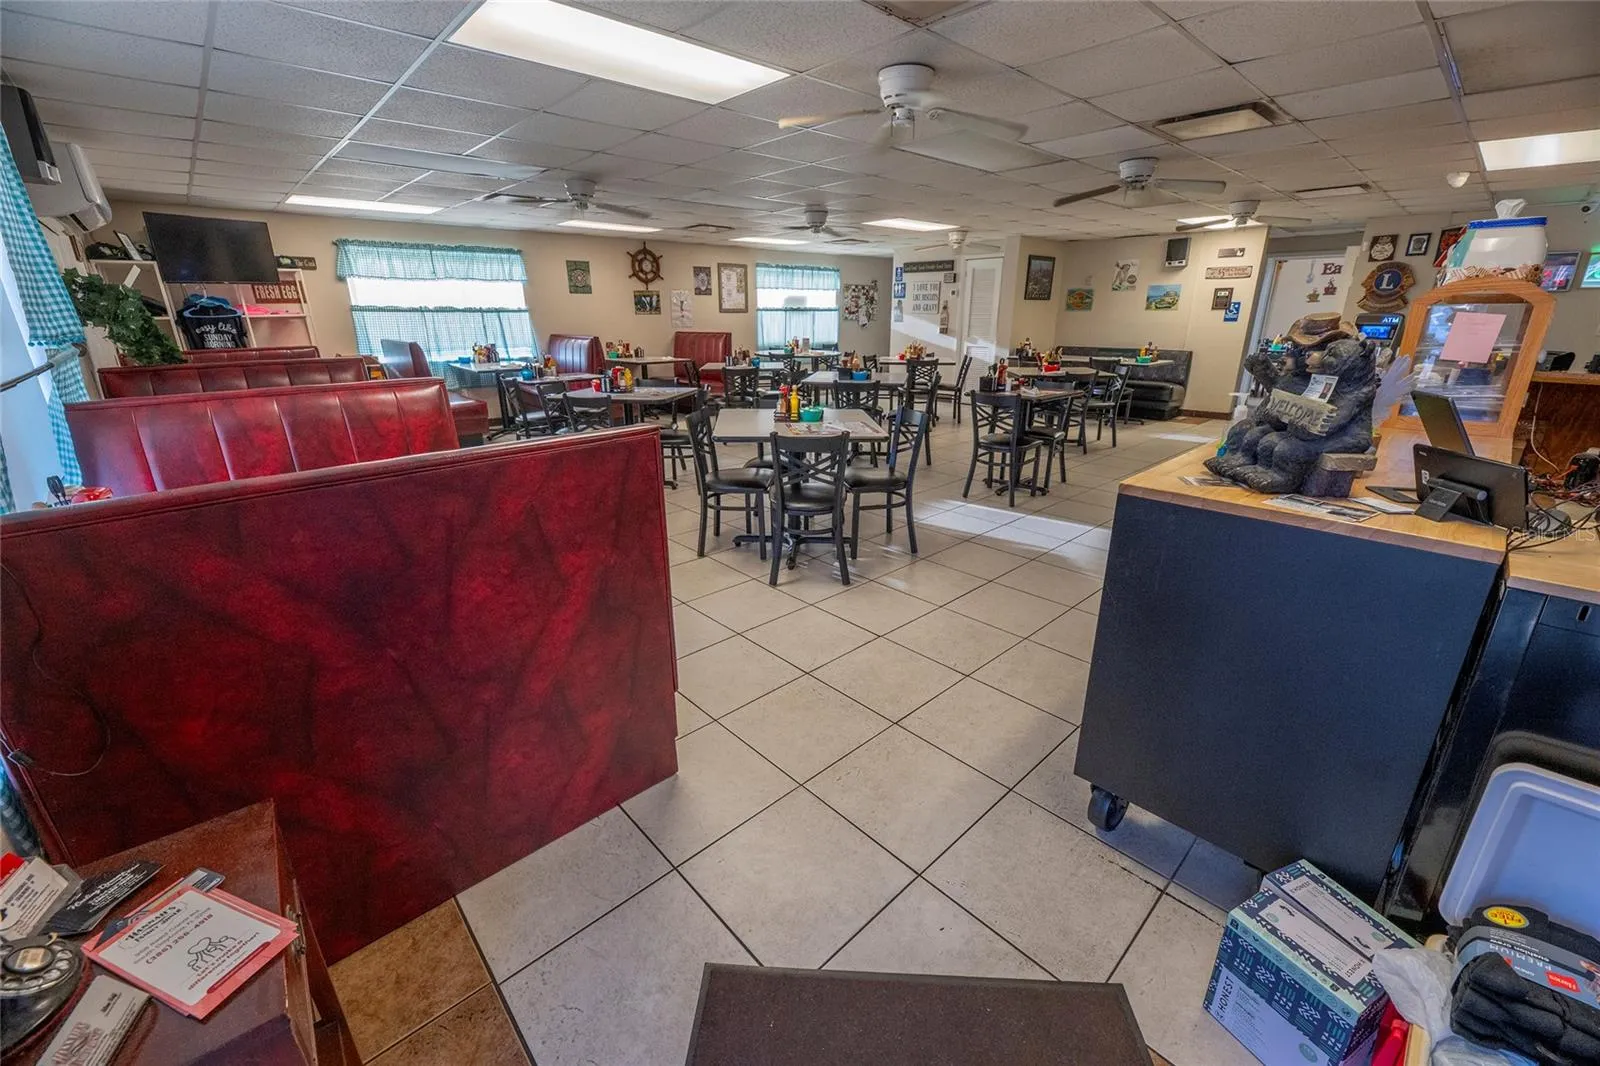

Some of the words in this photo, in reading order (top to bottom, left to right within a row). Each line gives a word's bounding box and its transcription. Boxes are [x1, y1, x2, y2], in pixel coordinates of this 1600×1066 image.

[1321, 263, 1343, 275] Ea
[917, 283, 928, 291] LOVE
[930, 283, 939, 291] YOU
[1379, 273, 1394, 290] L
[254, 284, 281, 299] FRESH
[281, 284, 299, 299] EGG
[912, 303, 921, 311] AND
[922, 303, 937, 311] GRAVY
[1382, 316, 1400, 324] ATM
[195, 323, 217, 334] easy
[217, 321, 237, 334] like
[203, 333, 232, 342] SUNDAY
[1270, 396, 1321, 427] WELCOME
[1489, 944, 1552, 970] PREMIUM
[1218, 975, 1235, 1013] HONEST
